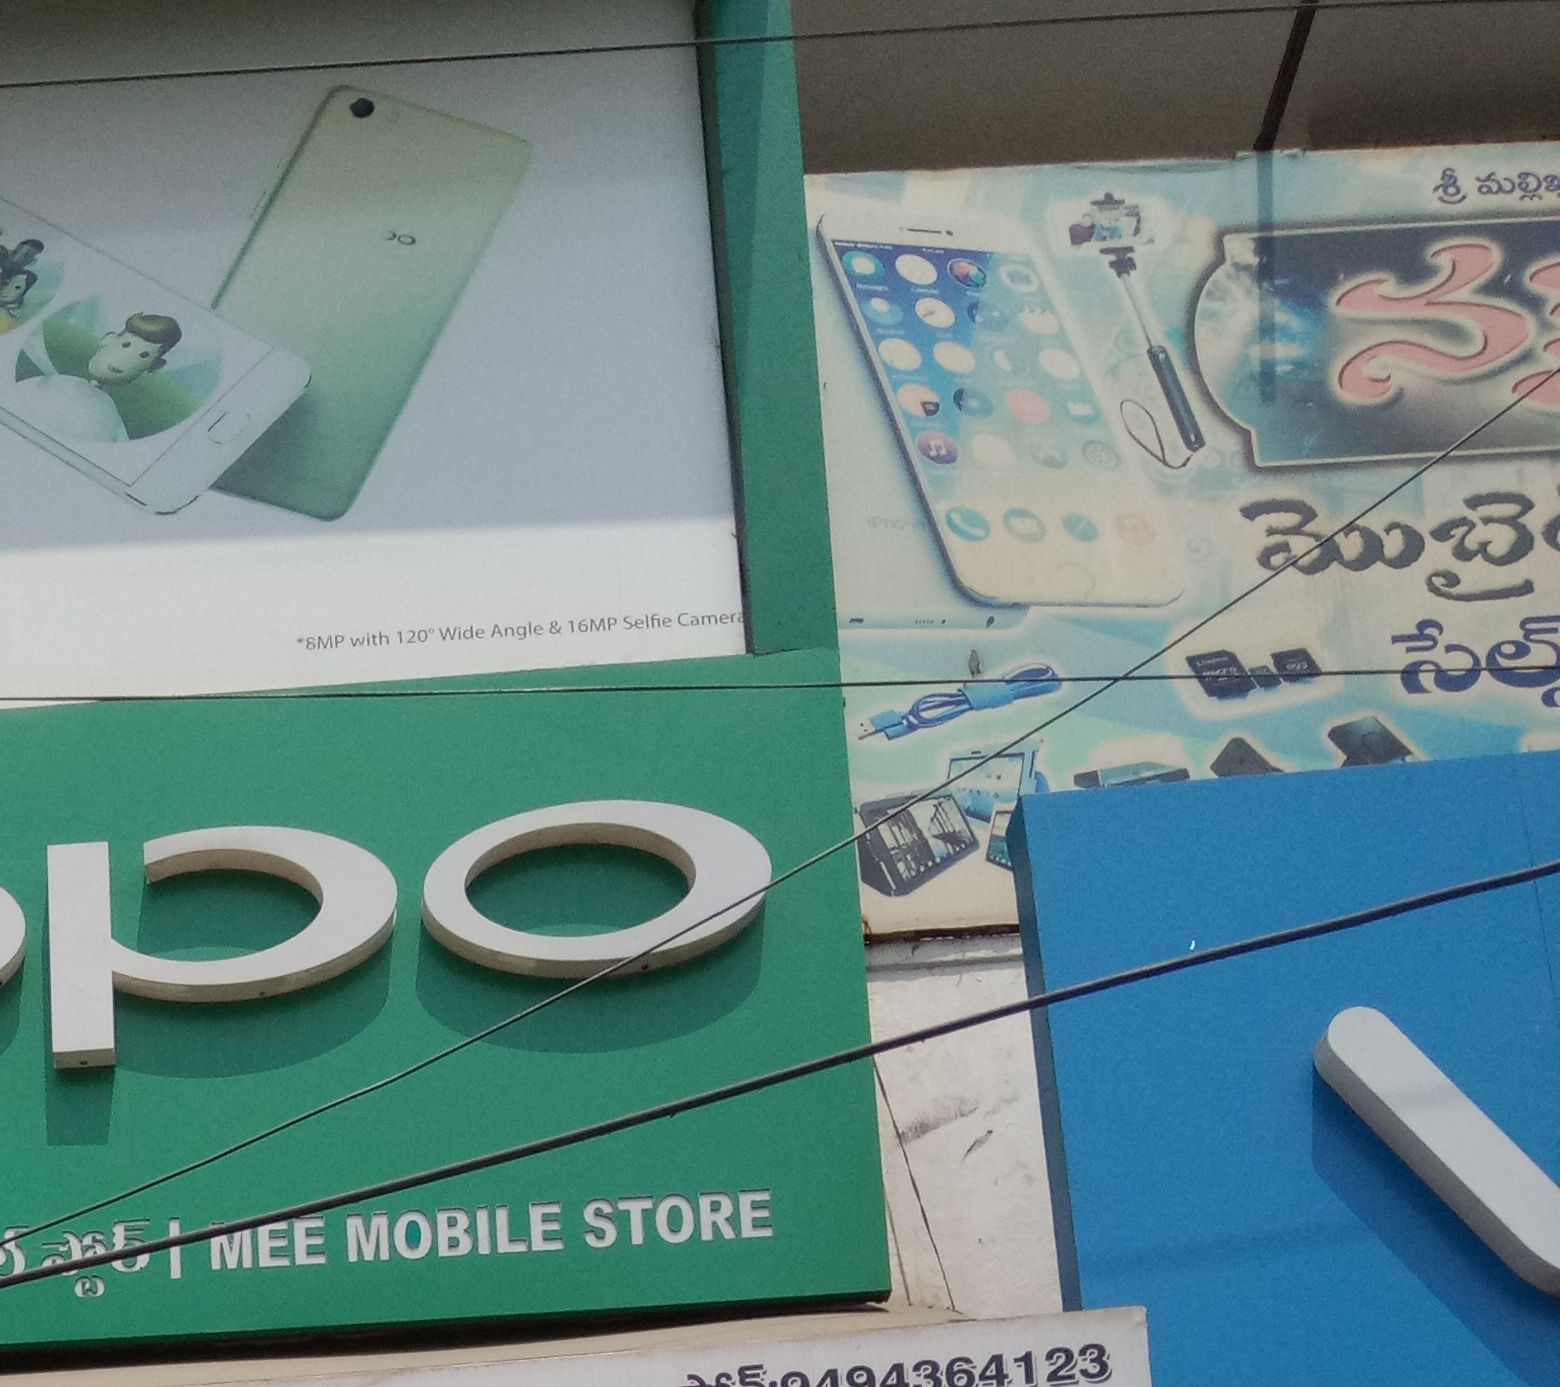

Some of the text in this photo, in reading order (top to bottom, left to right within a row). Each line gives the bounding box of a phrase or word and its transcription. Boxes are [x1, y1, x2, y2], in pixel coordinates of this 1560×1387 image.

[349, 629, 392, 649] with
[395, 626, 436, 647] 120°
[439, 623, 485, 644] Wide
[490, 619, 545, 645] Angle
[548, 618, 564, 636] &
[568, 615, 619, 634] 16MP
[622, 612, 674, 631] Selfie
[210, 1188, 774, 1271] MEE MOBILE STORE
